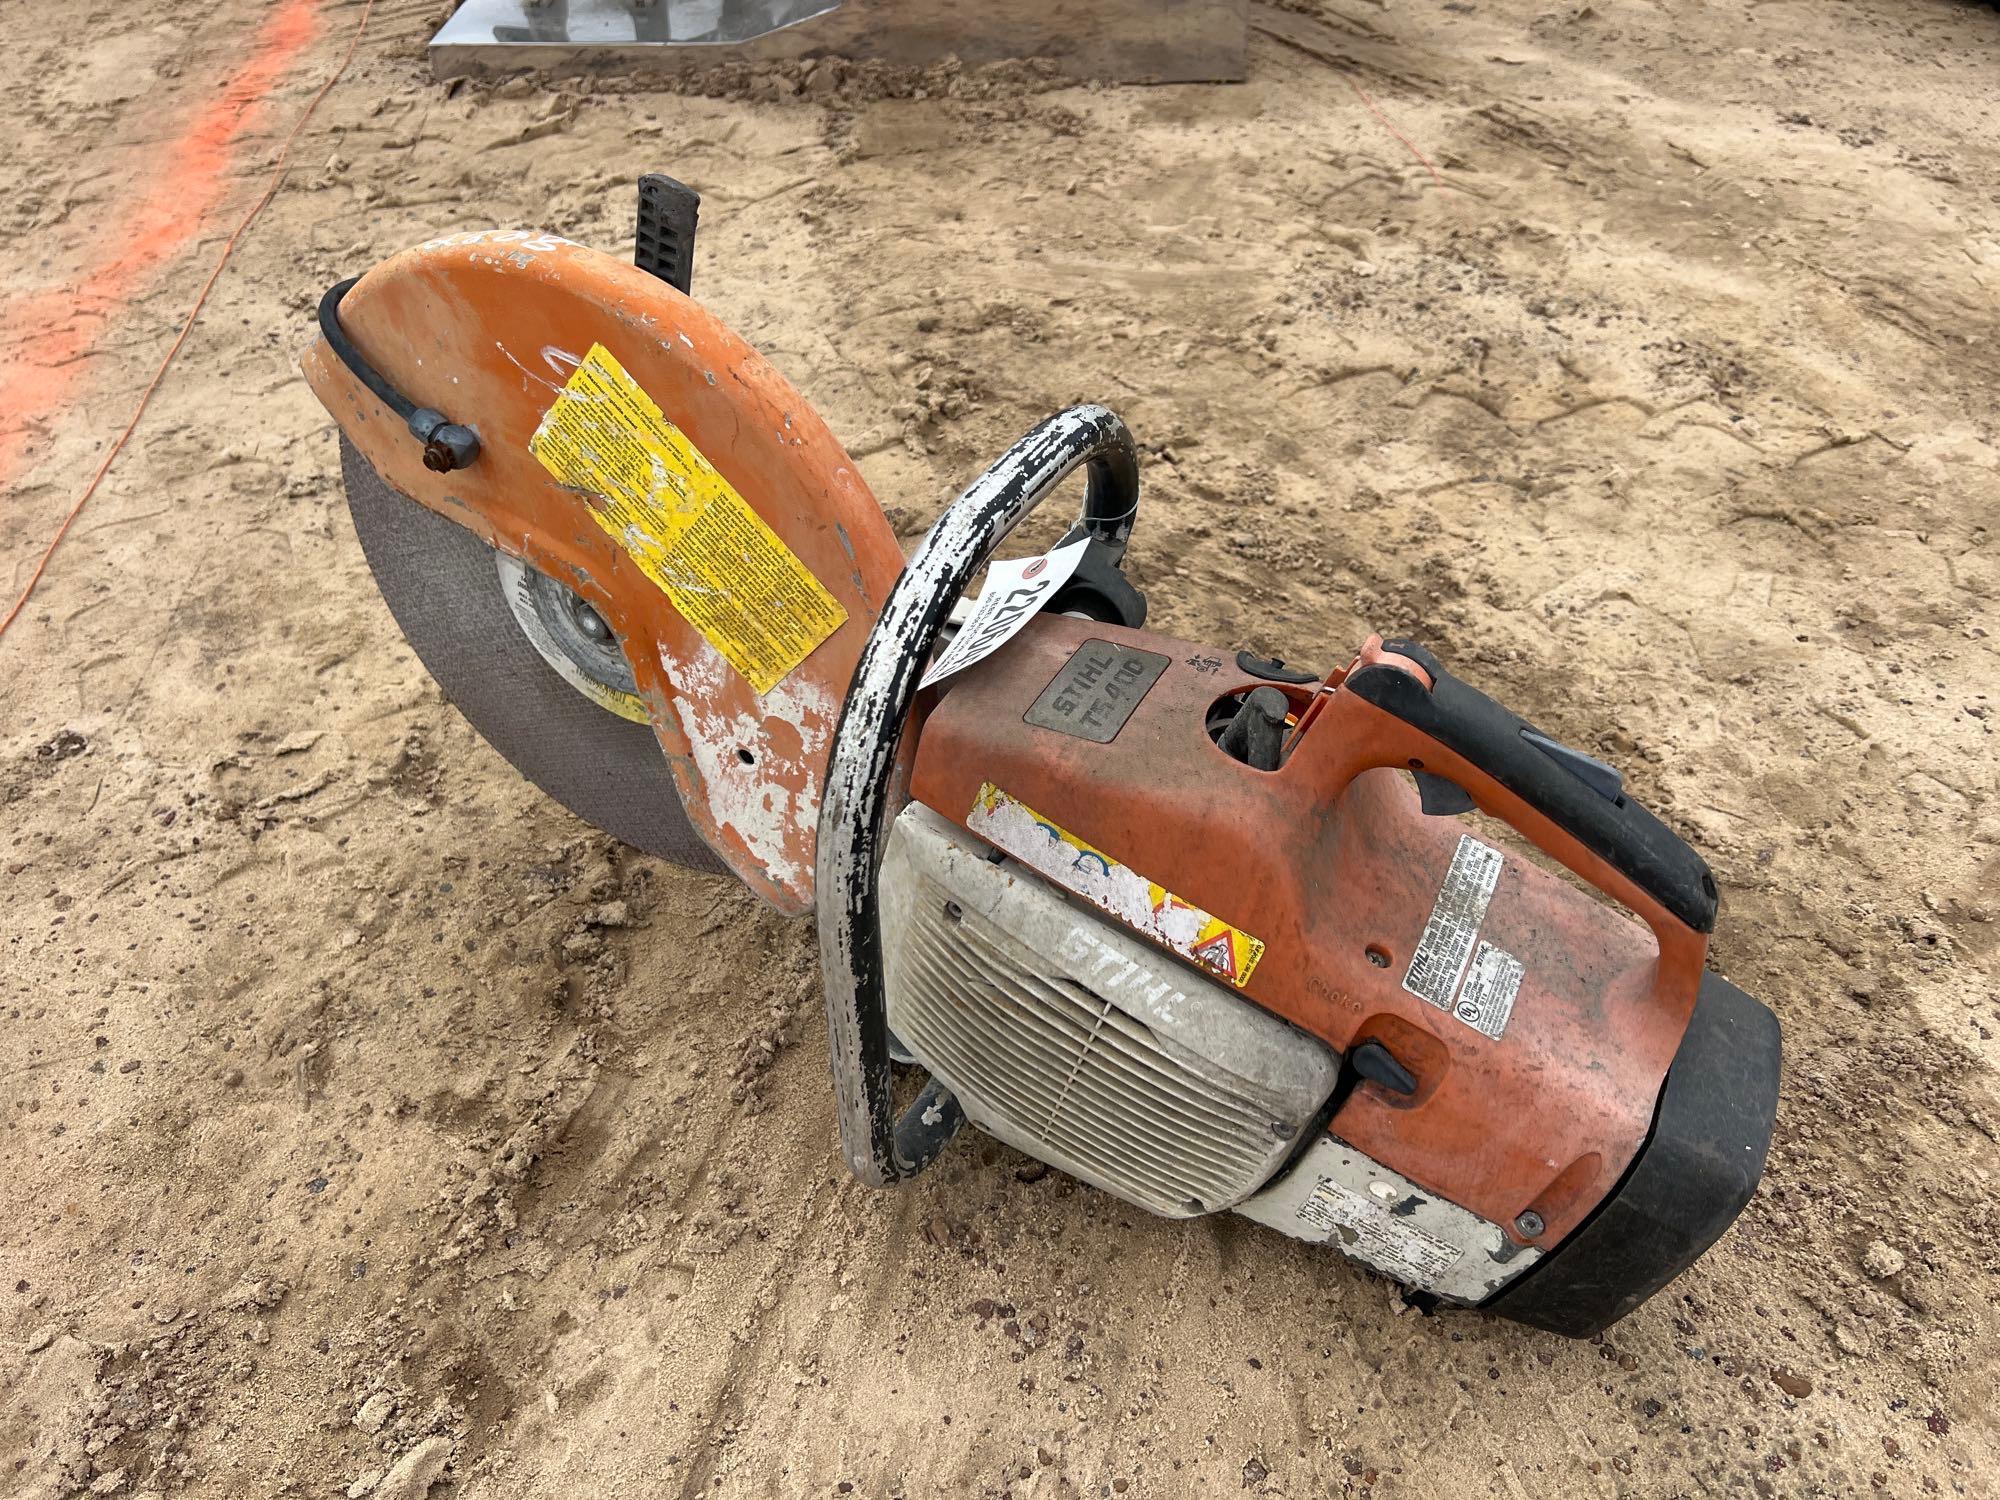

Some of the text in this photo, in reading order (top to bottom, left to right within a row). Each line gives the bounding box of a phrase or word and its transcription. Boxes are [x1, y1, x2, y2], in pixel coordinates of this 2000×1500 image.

[1053, 656, 1114, 717] STIHL
[1406, 949, 1428, 990] STIHL
[1462, 981, 1472, 997] LISTED
[1475, 944, 1488, 967] STIHL
[1468, 971, 1482, 1000] CUTTING-OFF
[1473, 982, 1484, 1003] MACHINE
